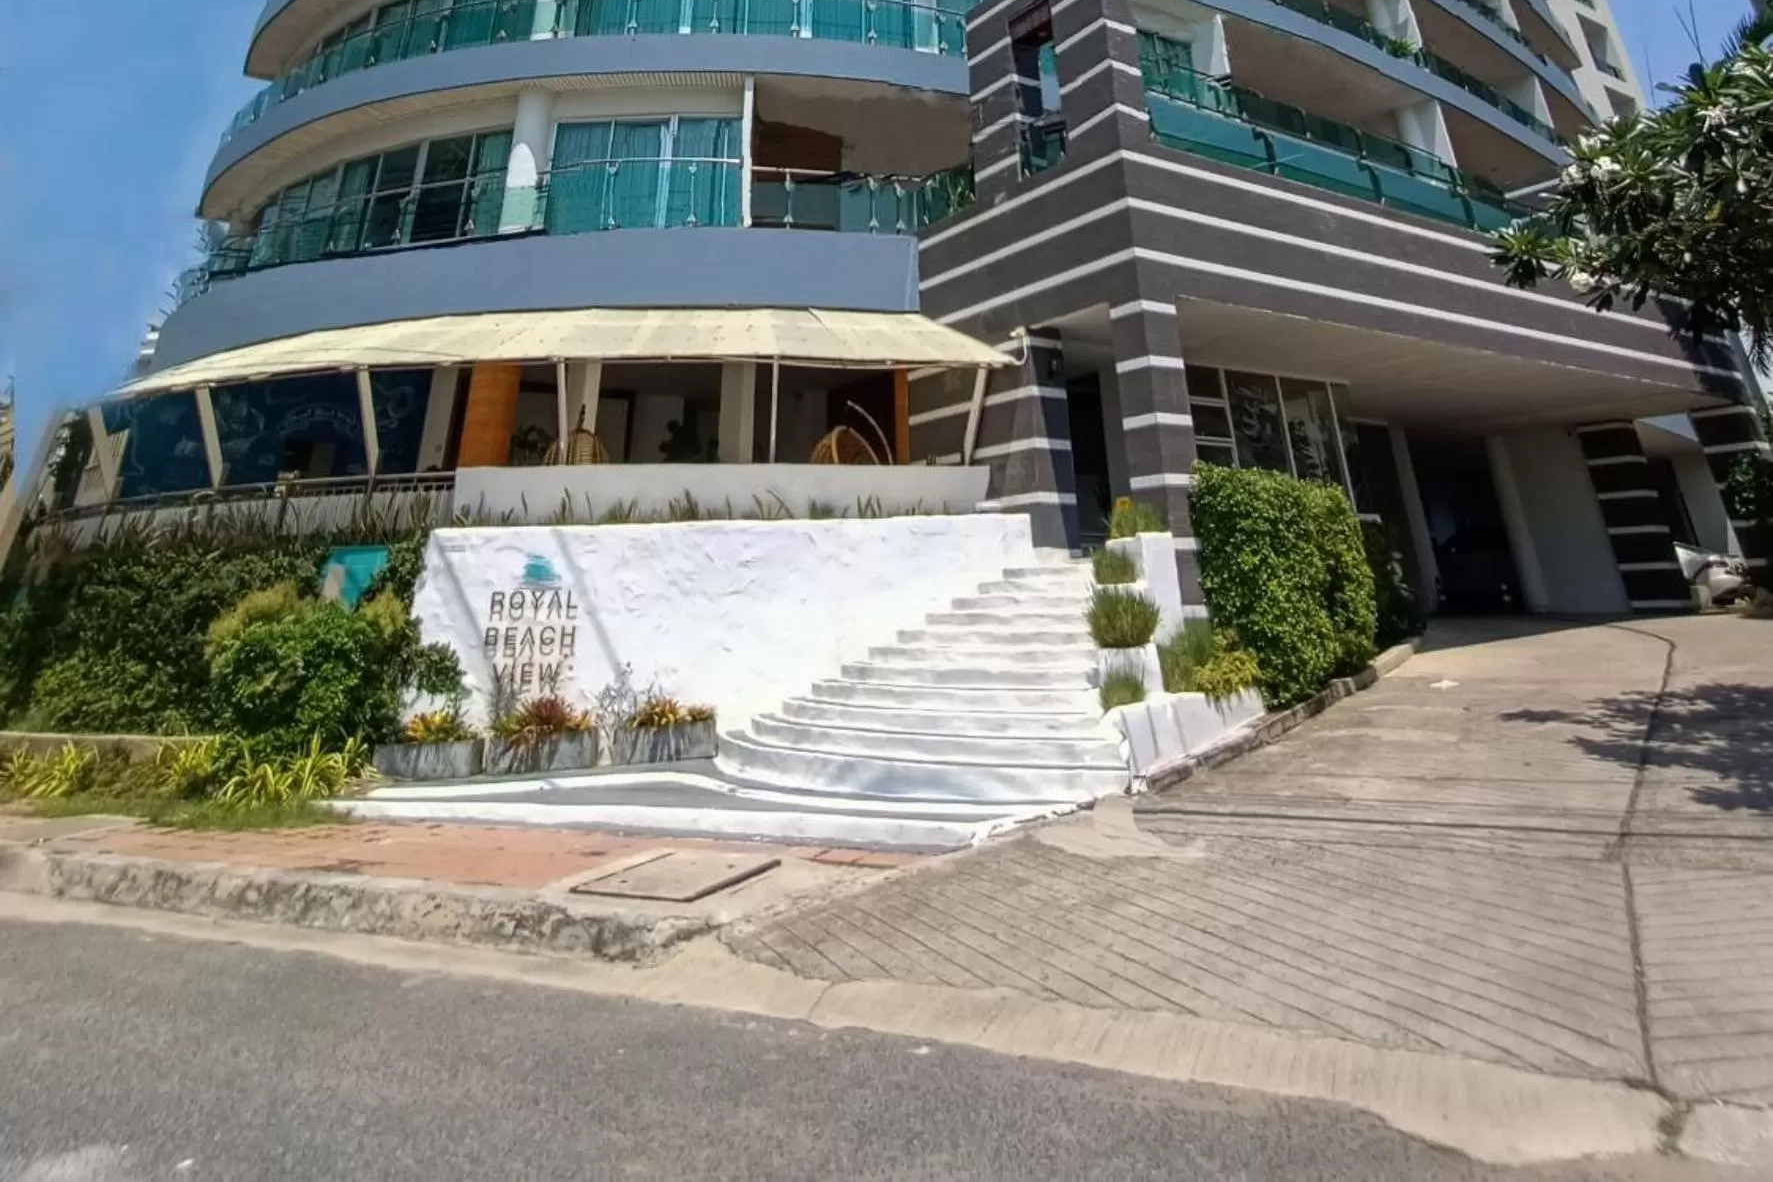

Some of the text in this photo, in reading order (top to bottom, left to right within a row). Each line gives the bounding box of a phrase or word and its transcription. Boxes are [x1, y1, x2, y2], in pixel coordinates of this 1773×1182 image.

[490, 589, 578, 614] ROYAL
[484, 625, 576, 650] BEACH
[492, 661, 562, 687] VIEW
